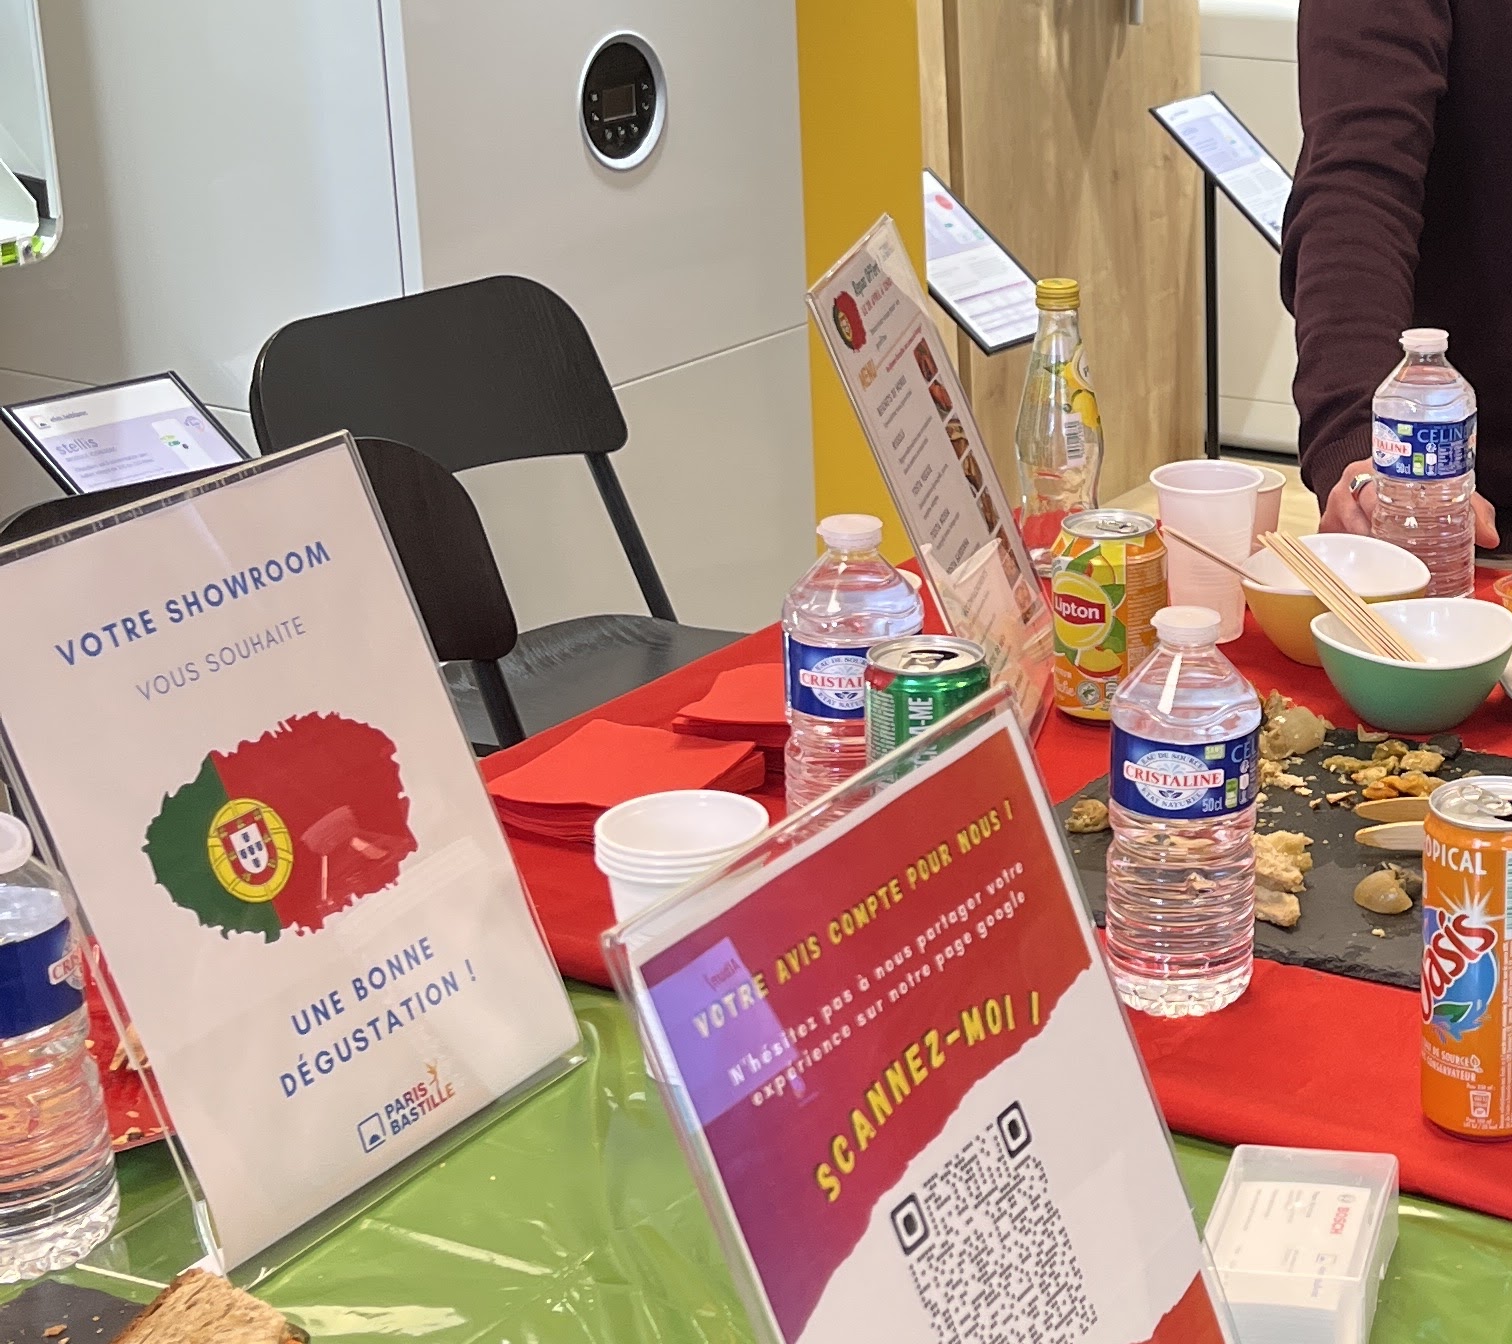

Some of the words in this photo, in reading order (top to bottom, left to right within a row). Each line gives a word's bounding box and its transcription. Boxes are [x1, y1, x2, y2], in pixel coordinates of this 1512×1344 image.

[55, 436, 99, 456] stellis
[55, 609, 157, 666] VOTRE
[165, 541, 331, 624] SHOWROOM
[1055, 596, 1100, 620] Lipton
[135, 662, 200, 701] VOUS
[205, 616, 306, 673] SOUHAITE
[1125, 764, 1222, 787] CRISTALINE
[1202, 796, 1222, 813] 50cl
[692, 973, 770, 1039] VOTRE
[774, 935, 822, 985] AVIS
[827, 877, 903, 945] COMPTE
[906, 842, 953, 890] POUR
[956, 809, 1002, 854] NOUS
[854, 998, 885, 1027] sur
[888, 962, 932, 1003] notre
[934, 931, 973, 973] page
[975, 889, 1026, 939] google
[291, 990, 345, 1035] UNE
[351, 936, 434, 1002] BONNE
[727, 1015, 819, 1087] N'hésitez
[821, 989, 853, 1024] pas
[856, 973, 871, 992] à
[873, 945, 914, 981] nous
[916, 891, 983, 954] partager
[985, 861, 1025, 897] votre
[278, 971, 459, 1098] DÉGUSTATION
[464, 959, 476, 982] !
[384, 1082, 429, 1120] PARIS
[389, 1081, 456, 1136] BASTILLE
[816, 994, 1015, 1202] SCANNEZ-MOI
[1329, 1207, 1351, 1235] BOSCH
